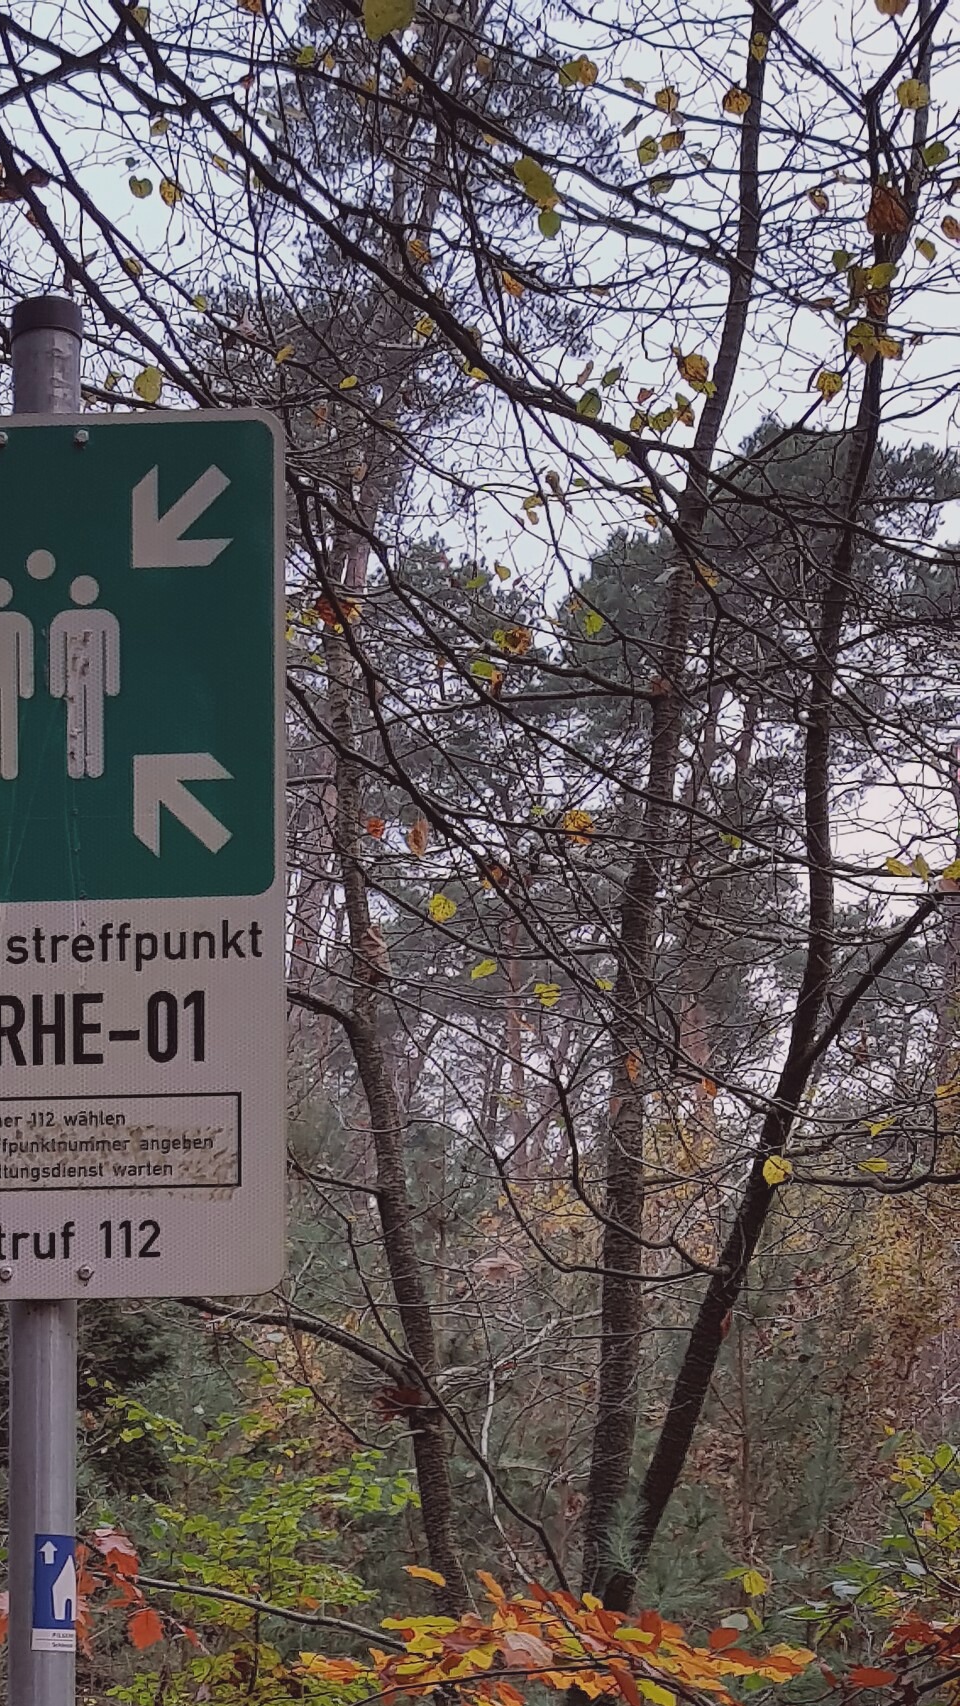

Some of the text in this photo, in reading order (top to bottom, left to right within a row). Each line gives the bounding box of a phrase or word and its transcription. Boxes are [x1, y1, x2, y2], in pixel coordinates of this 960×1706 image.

[63, 1110, 126, 1126] wählen
[139, 1134, 215, 1153] angeben
[113, 1161, 174, 1178] warten
[100, 1220, 161, 1259] 112
